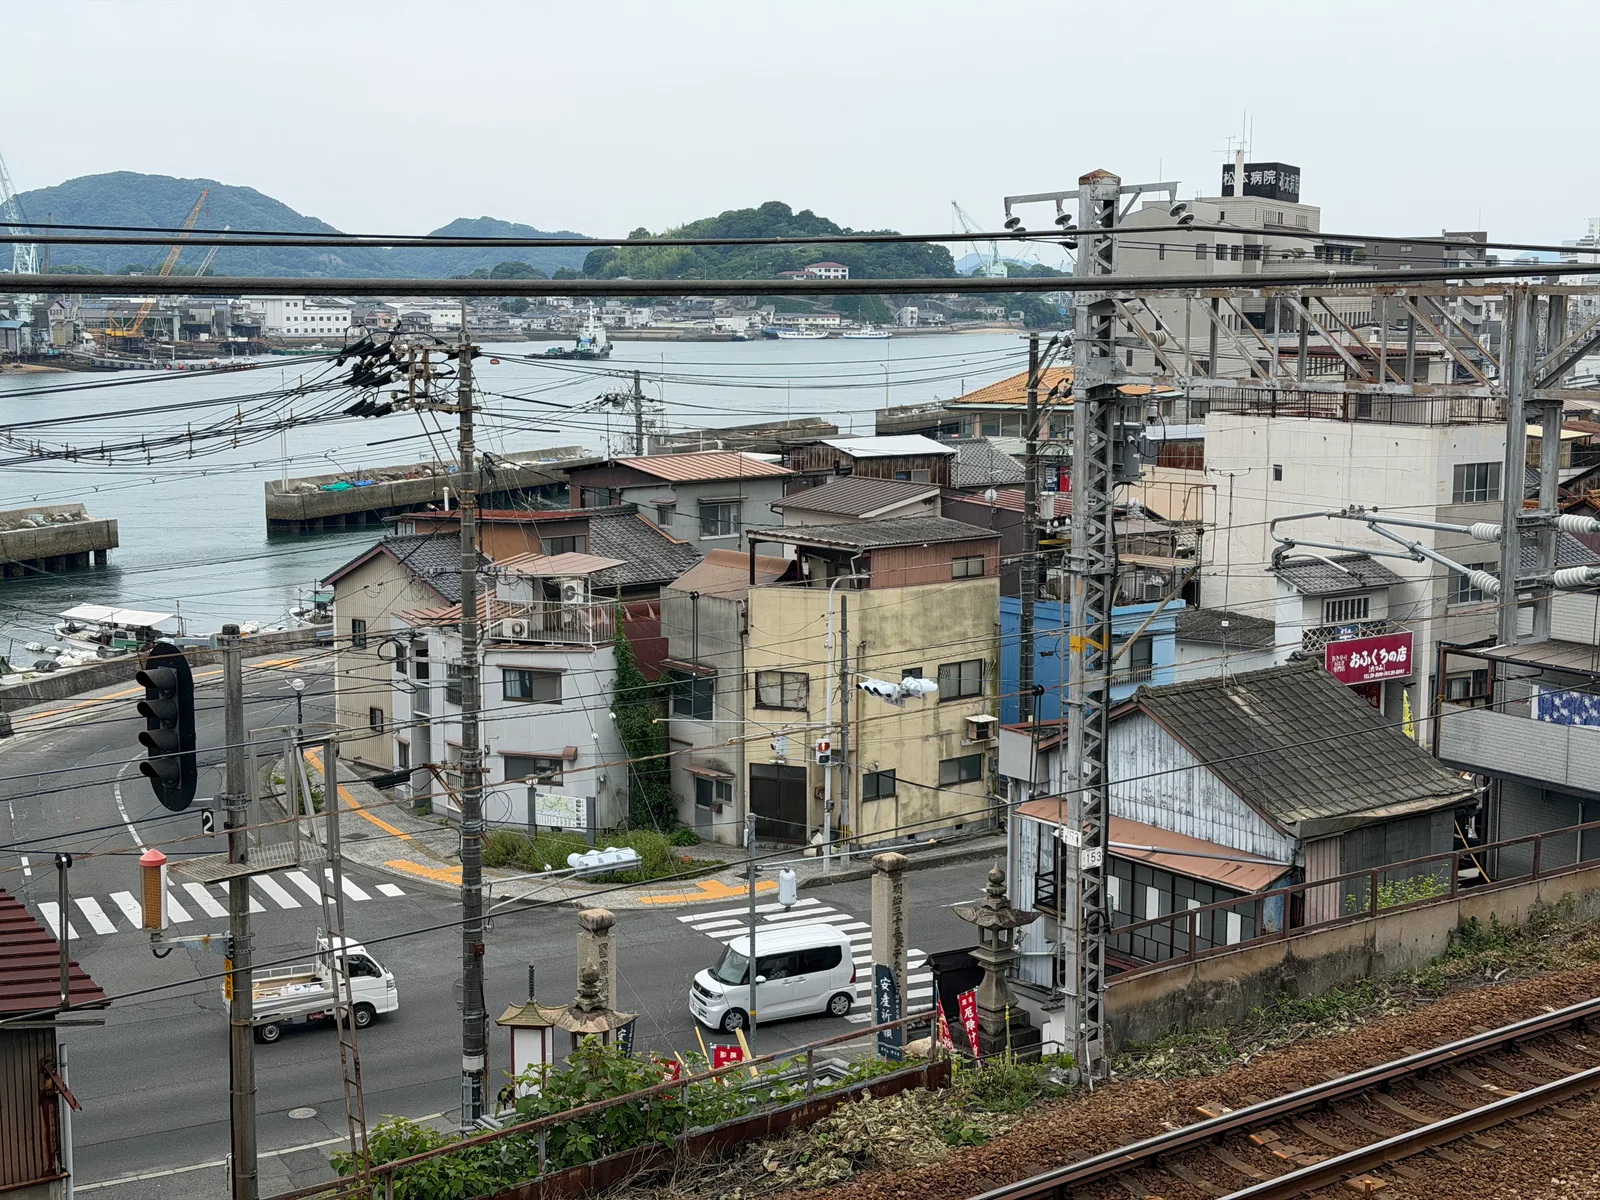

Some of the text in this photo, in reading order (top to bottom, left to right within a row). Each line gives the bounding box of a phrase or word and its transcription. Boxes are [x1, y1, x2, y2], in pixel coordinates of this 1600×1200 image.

[1349, 645, 1407, 668] おふくろの店
[202, 811, 214, 834] 2
[1086, 851, 1102, 864] 153
